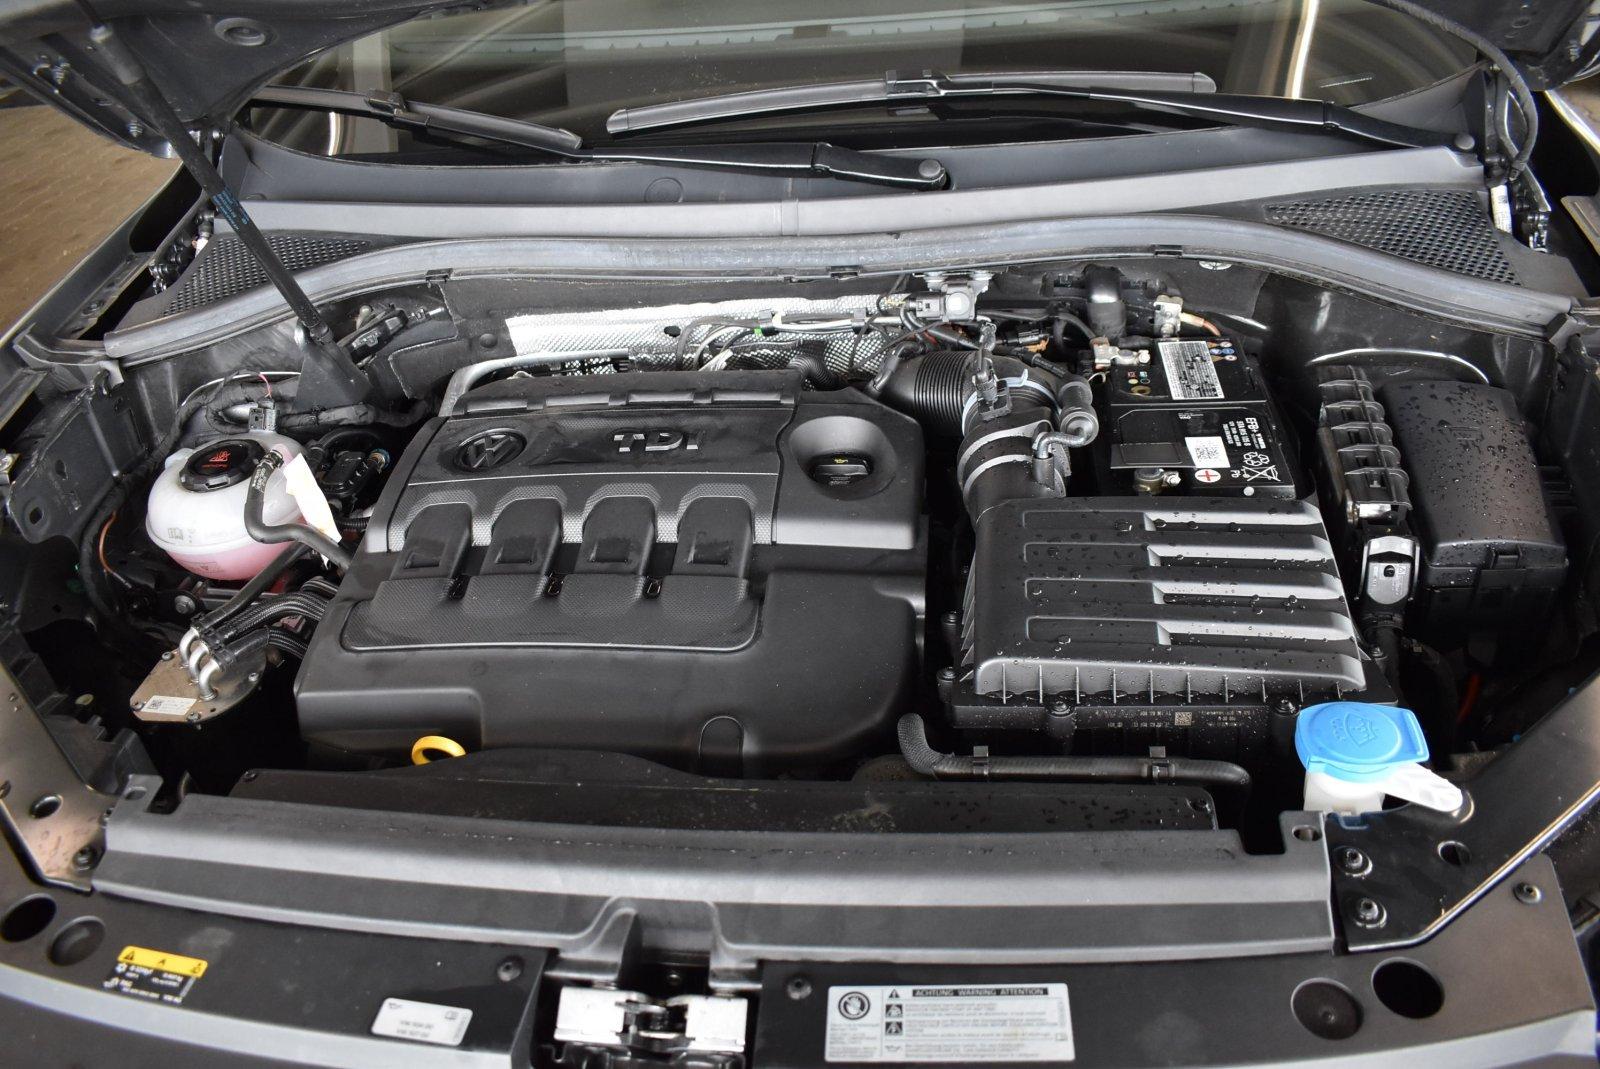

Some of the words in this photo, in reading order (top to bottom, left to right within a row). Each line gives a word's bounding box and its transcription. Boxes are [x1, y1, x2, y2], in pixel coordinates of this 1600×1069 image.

[612, 431, 699, 453] TDI
[915, 989, 954, 997] ACHTUNG
[958, 988, 997, 996] WARNING
[1000, 987, 1044, 996] ATTENTION
